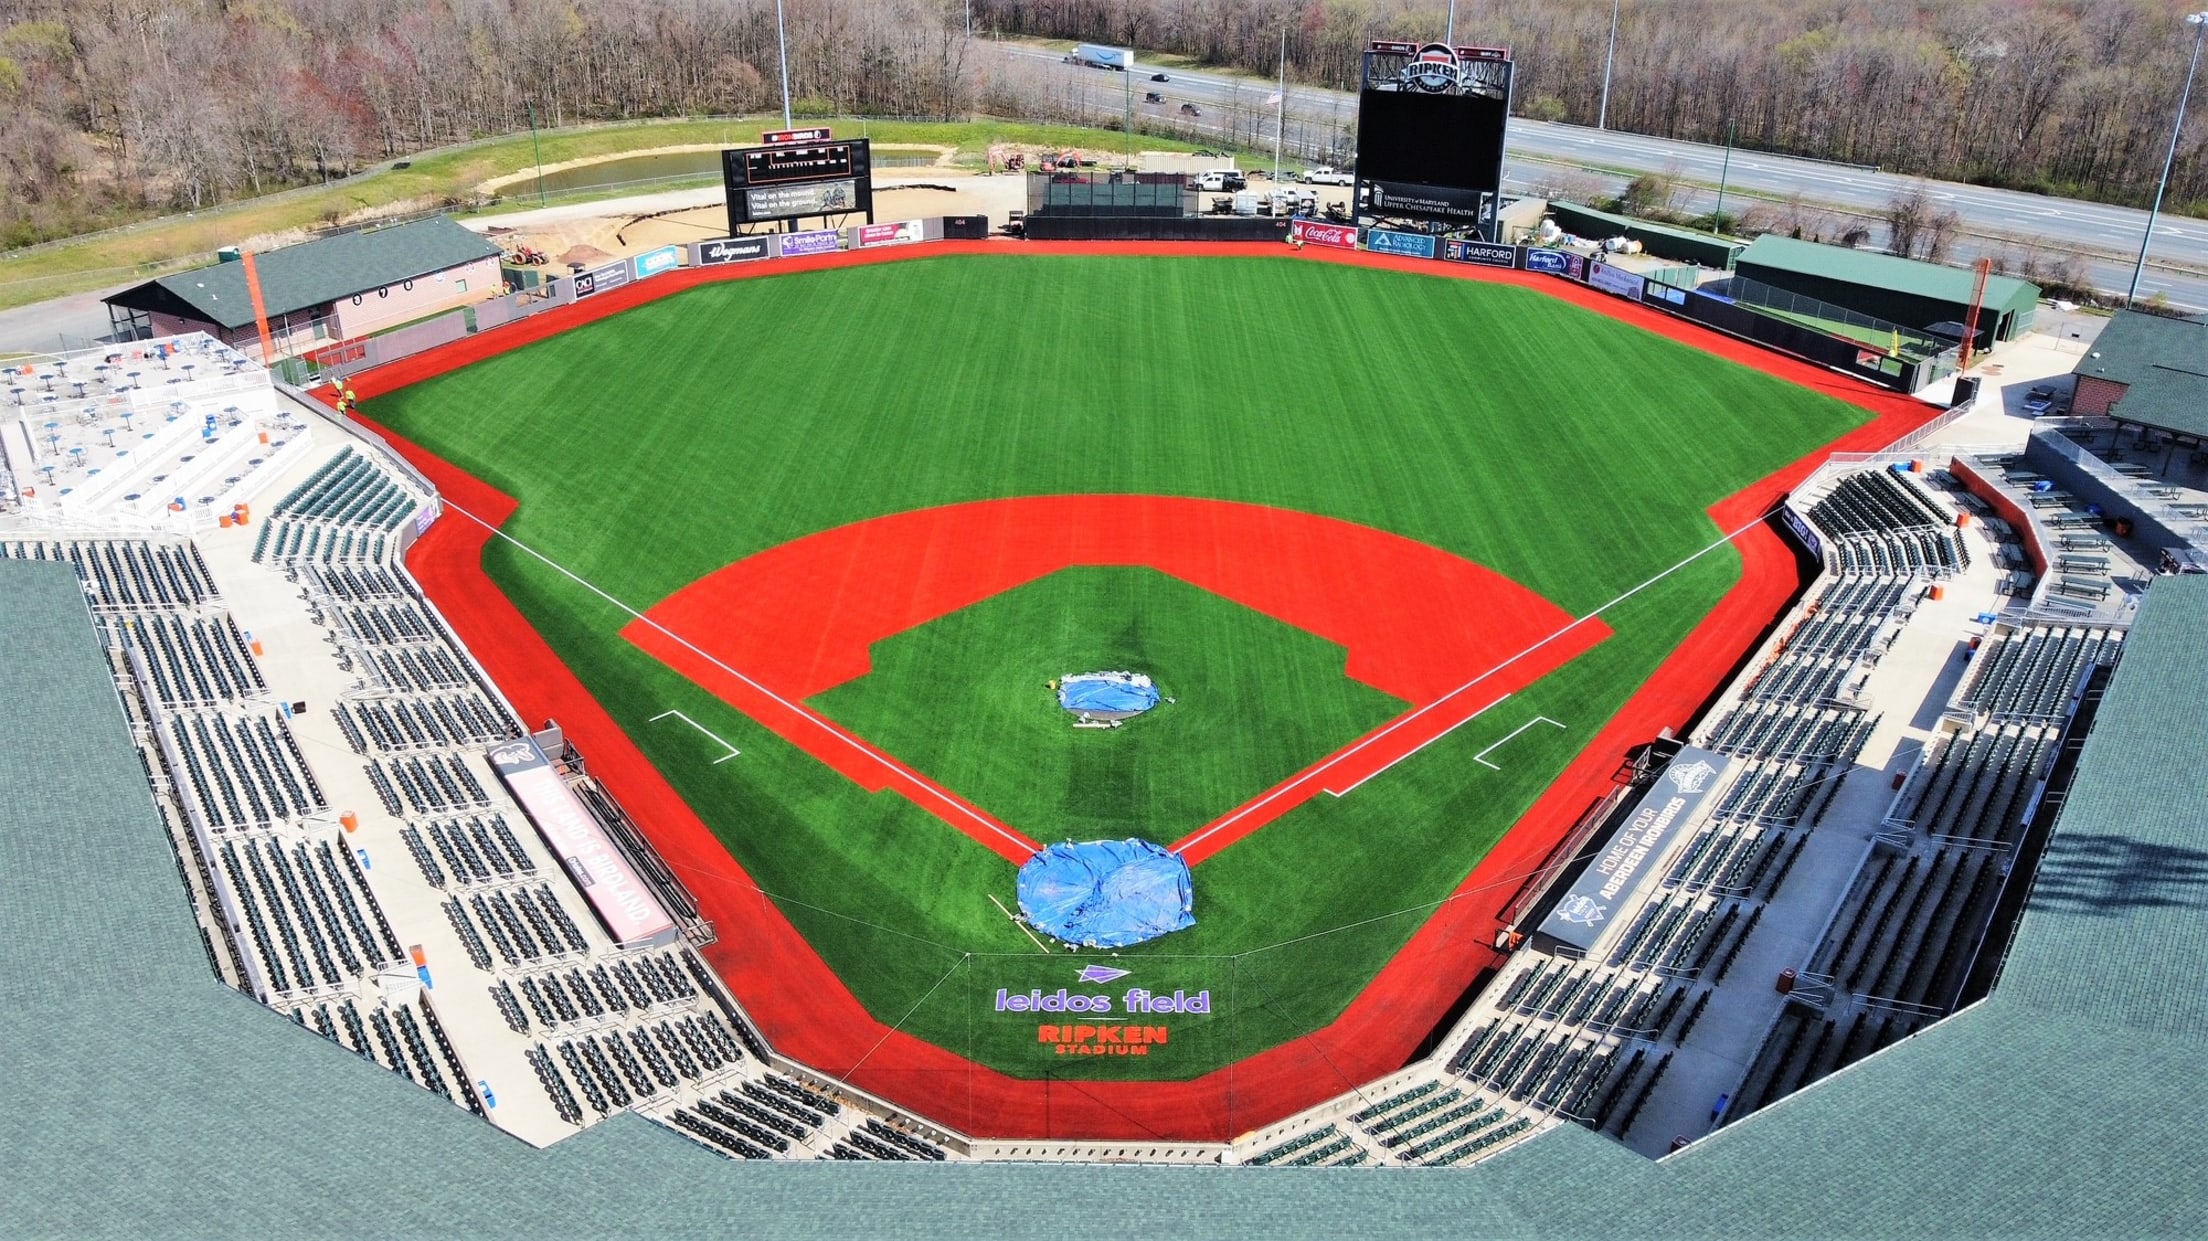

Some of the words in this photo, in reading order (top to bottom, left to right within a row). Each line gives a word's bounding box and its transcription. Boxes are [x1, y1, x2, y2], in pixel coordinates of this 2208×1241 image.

[1409, 62, 1458, 79] RIPKEN
[751, 192, 767, 201] Vital
[778, 190, 790, 198] the
[1384, 194, 1415, 203] UNIVERSITY
[1420, 199, 1450, 207] MARYLAND
[751, 201, 768, 210] Vital
[779, 199, 790, 207] the
[1383, 200, 1404, 209] UPPER
[1405, 203, 1445, 214] CHESAPEAKE
[1447, 207, 1474, 217] HEALTH
[709, 241, 761, 262] Wegmans
[1466, 246, 1513, 260] HARFORD
[1628, 807, 1659, 832] YOUR
[1619, 831, 1638, 847] OF
[1599, 843, 1650, 900] ABERDEEN
[1639, 796, 1686, 847] IRONBIRDS
[1596, 844, 1628, 875] HOME
[995, 988, 1112, 1012] leidos
[1123, 988, 1211, 1013] field
[1038, 1024, 1168, 1044] RIPKEN
[1055, 1044, 1148, 1055] STADIUM
